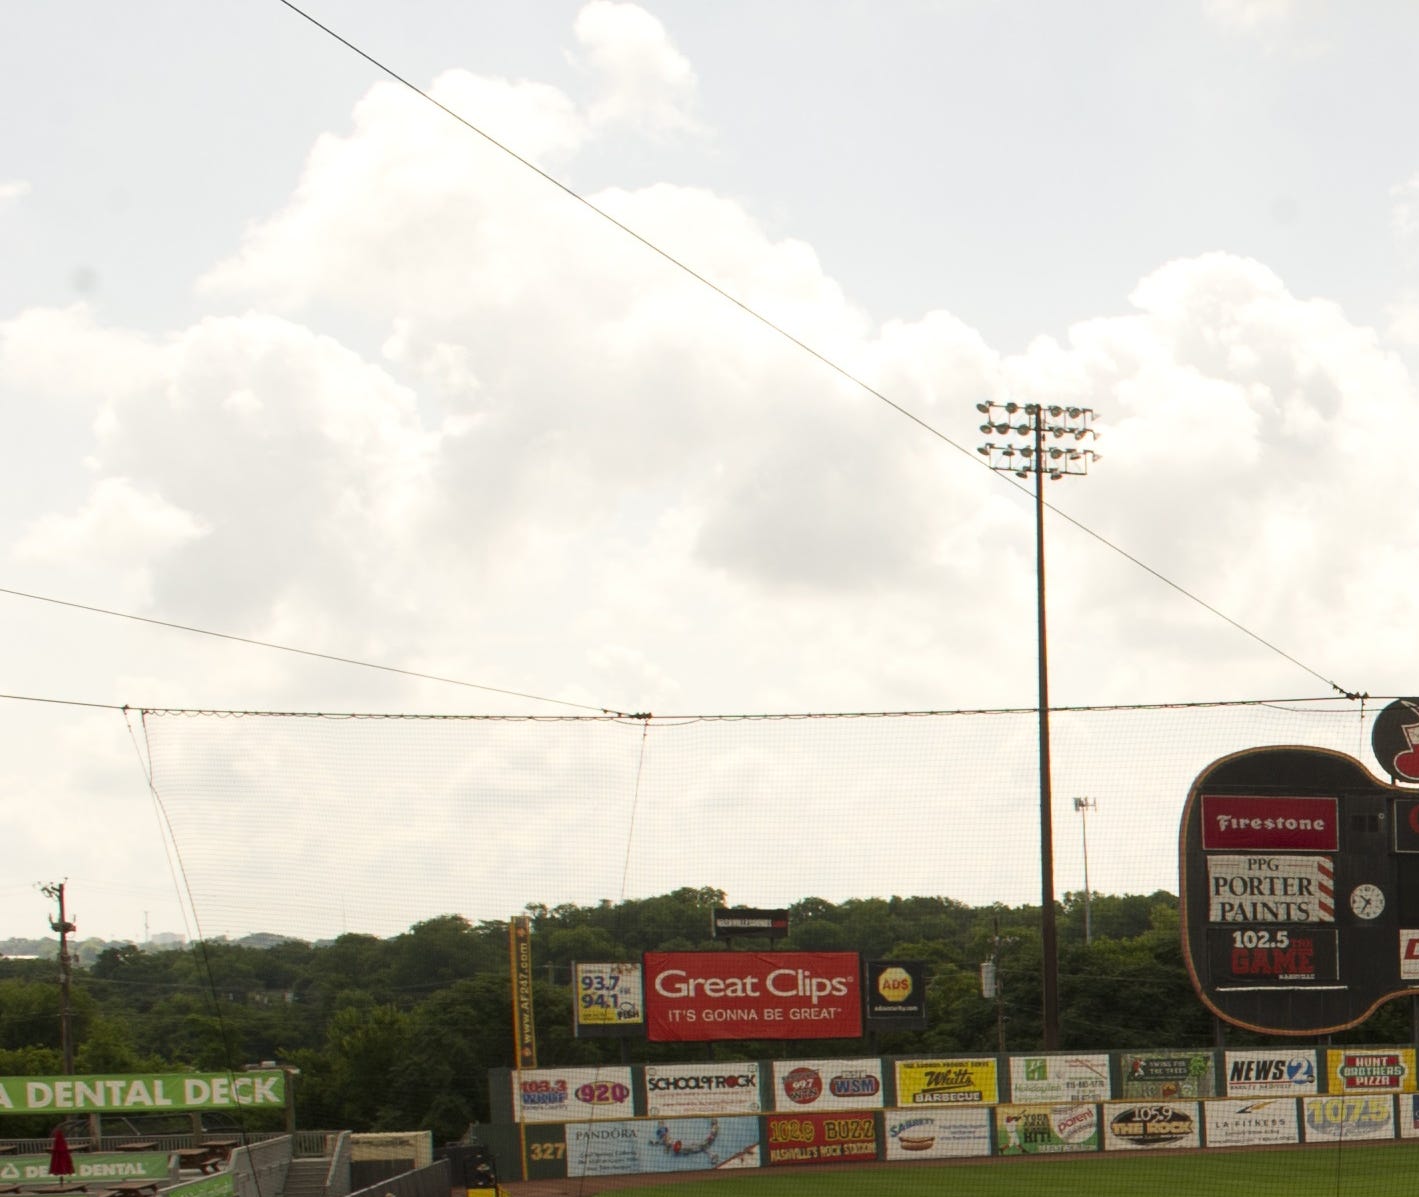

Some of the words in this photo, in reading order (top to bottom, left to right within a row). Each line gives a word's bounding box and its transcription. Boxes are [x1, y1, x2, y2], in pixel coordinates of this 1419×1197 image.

[1216, 815, 1325, 831] Firestone
[1248, 858, 1280, 871] PPG
[1213, 876, 1315, 896] PORTER
[1220, 901, 1310, 921] PAINTS
[1232, 930, 1290, 948] 102.5
[1231, 949, 1314, 974] GAME
[581, 975, 620, 991] 93.7
[655, 969, 760, 998] Great
[766, 969, 848, 1004] Clips
[882, 978, 909, 991] ADS
[582, 994, 619, 1009] 94.1
[669, 1008, 696, 1022] IT'S
[702, 1008, 758, 1022] GONNA
[764, 1008, 783, 1020] BE
[789, 1007, 836, 1020] GREAT
[1355, 1057, 1388, 1067] HUNT
[1230, 1060, 1287, 1081] NEWS
[1344, 1066, 1402, 1076] BROTHERS
[648, 1077, 703, 1091] SCHOOL
[834, 1078, 875, 1094] WSM
[1356, 1076, 1390, 1086] PIZZA
[26, 1080, 172, 1108] DENTAL
[184, 1077, 281, 1105] DECK
[914, 1092, 981, 1103] BARBECUE
[1132, 1105, 1173, 1121] 105.9
[1308, 1098, 1390, 1124] 107.5
[770, 1120, 815, 1143] 102.9
[823, 1118, 875, 1140] BUZZ
[1111, 1122, 1144, 1135] THE
[1147, 1120, 1194, 1134] ROCK
[1234, 1119, 1286, 1127] FITNESS
[530, 1142, 565, 1160] 327
[80, 1163, 146, 1176] DENTAL
